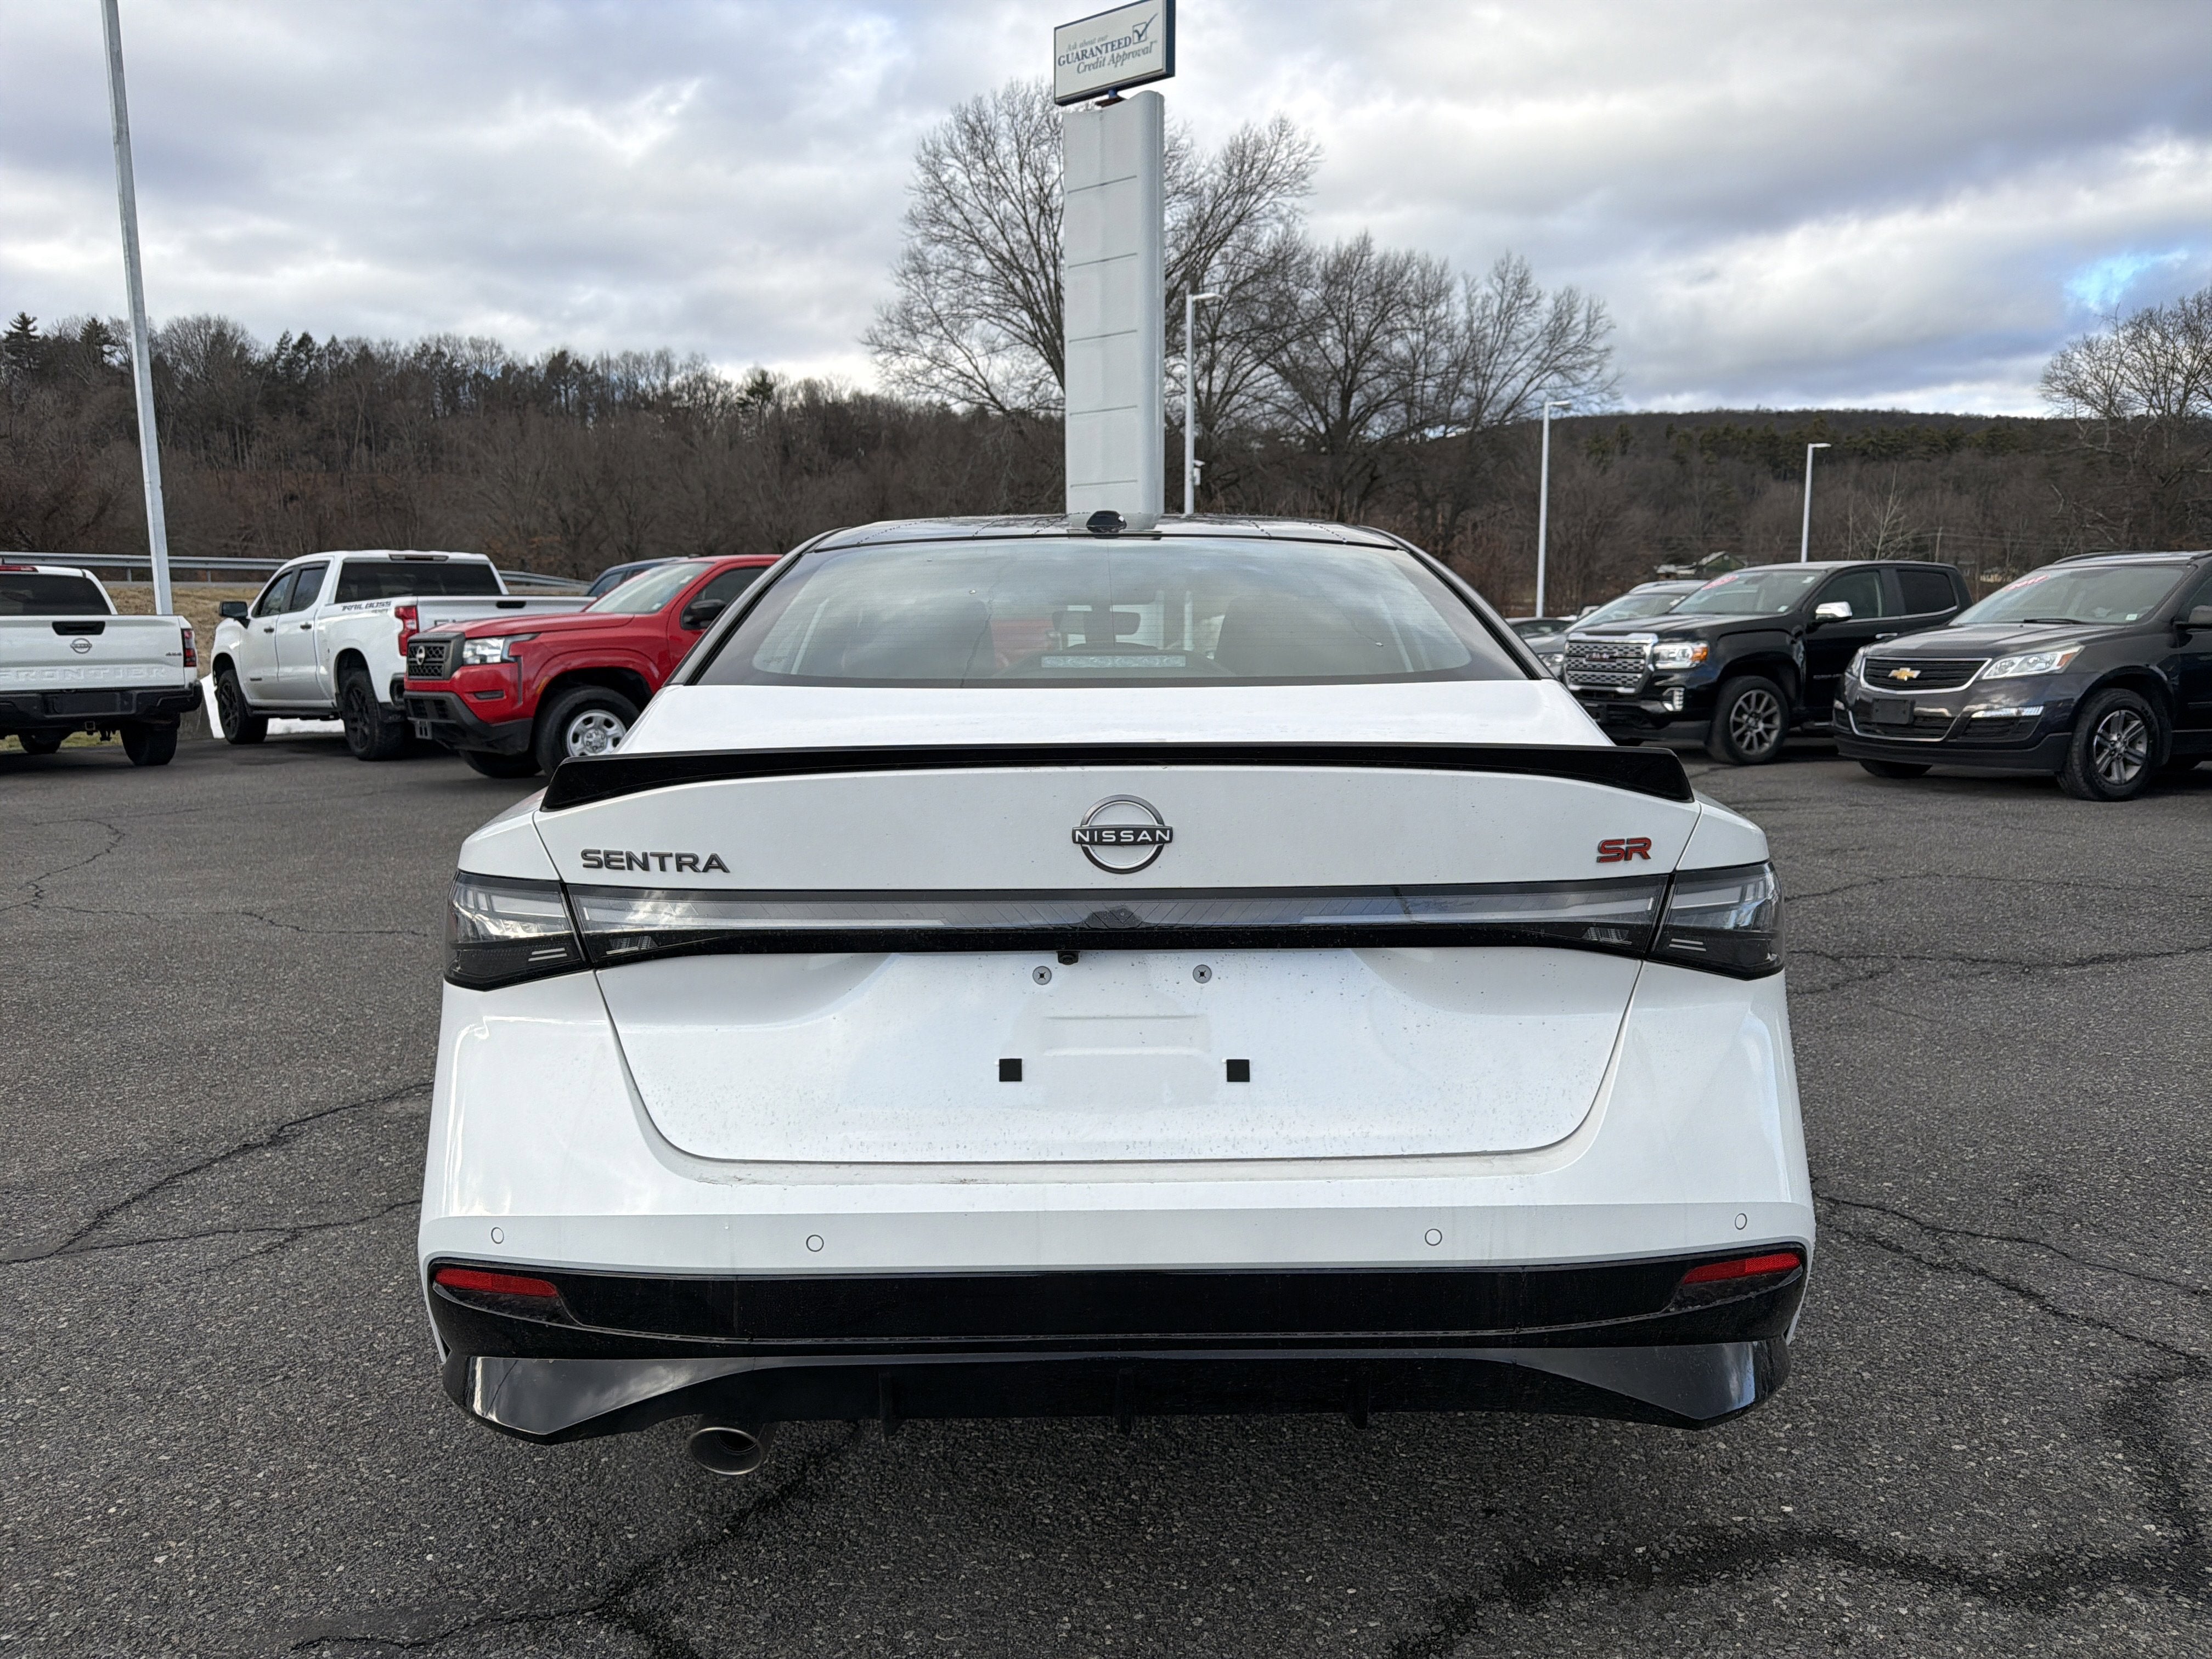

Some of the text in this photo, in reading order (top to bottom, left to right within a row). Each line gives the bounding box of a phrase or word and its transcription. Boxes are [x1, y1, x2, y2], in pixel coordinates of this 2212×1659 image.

[1058, 36, 1132, 66] GUARANTEED
[1077, 41, 1153, 74] Credit Approval
[1075, 830, 1170, 843] NISSAN
[580, 848, 730, 873] SENTRA
[1596, 837, 1652, 863] SR
